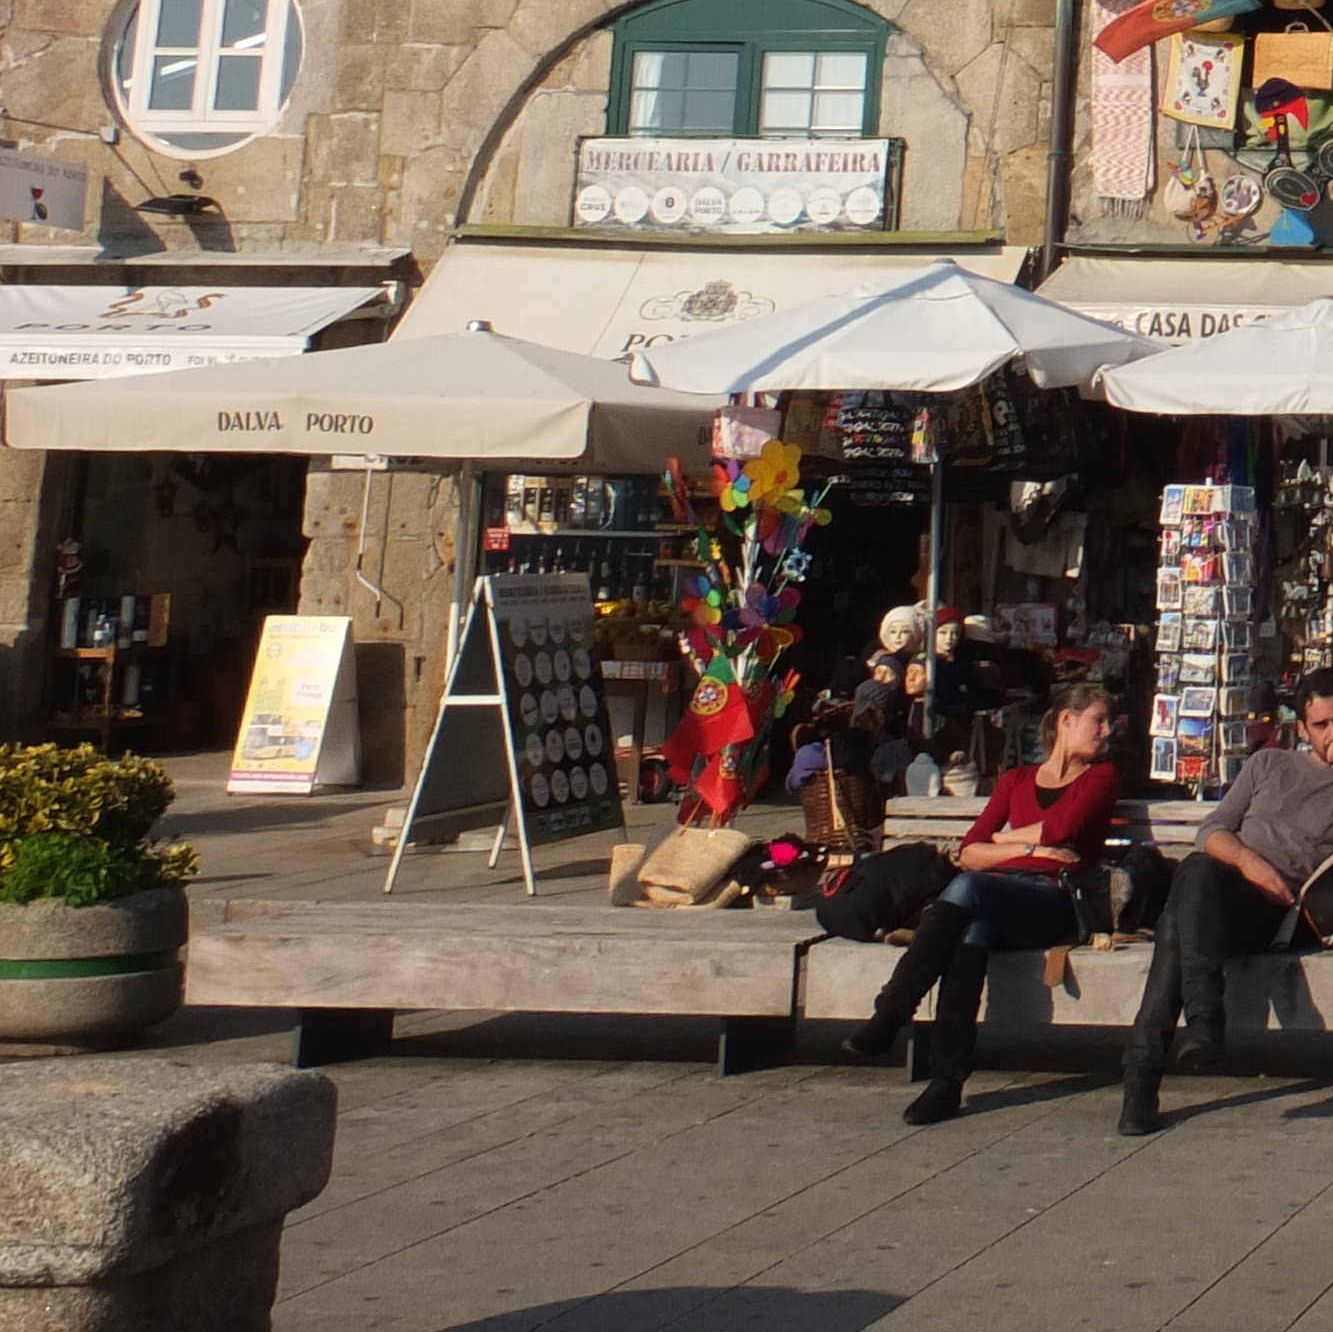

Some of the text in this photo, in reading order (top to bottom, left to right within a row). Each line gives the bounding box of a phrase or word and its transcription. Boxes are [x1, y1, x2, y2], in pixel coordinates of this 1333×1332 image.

[587, 150, 715, 172] MERCEARIA
[736, 152, 881, 173] GARRAFEIRA
[1135, 312, 1192, 338] CASA
[9, 352, 100, 365] AZEITONEIRA
[102, 352, 122, 365] DO
[126, 353, 172, 365] PORTO
[217, 411, 374, 435] DALVA PORTO
